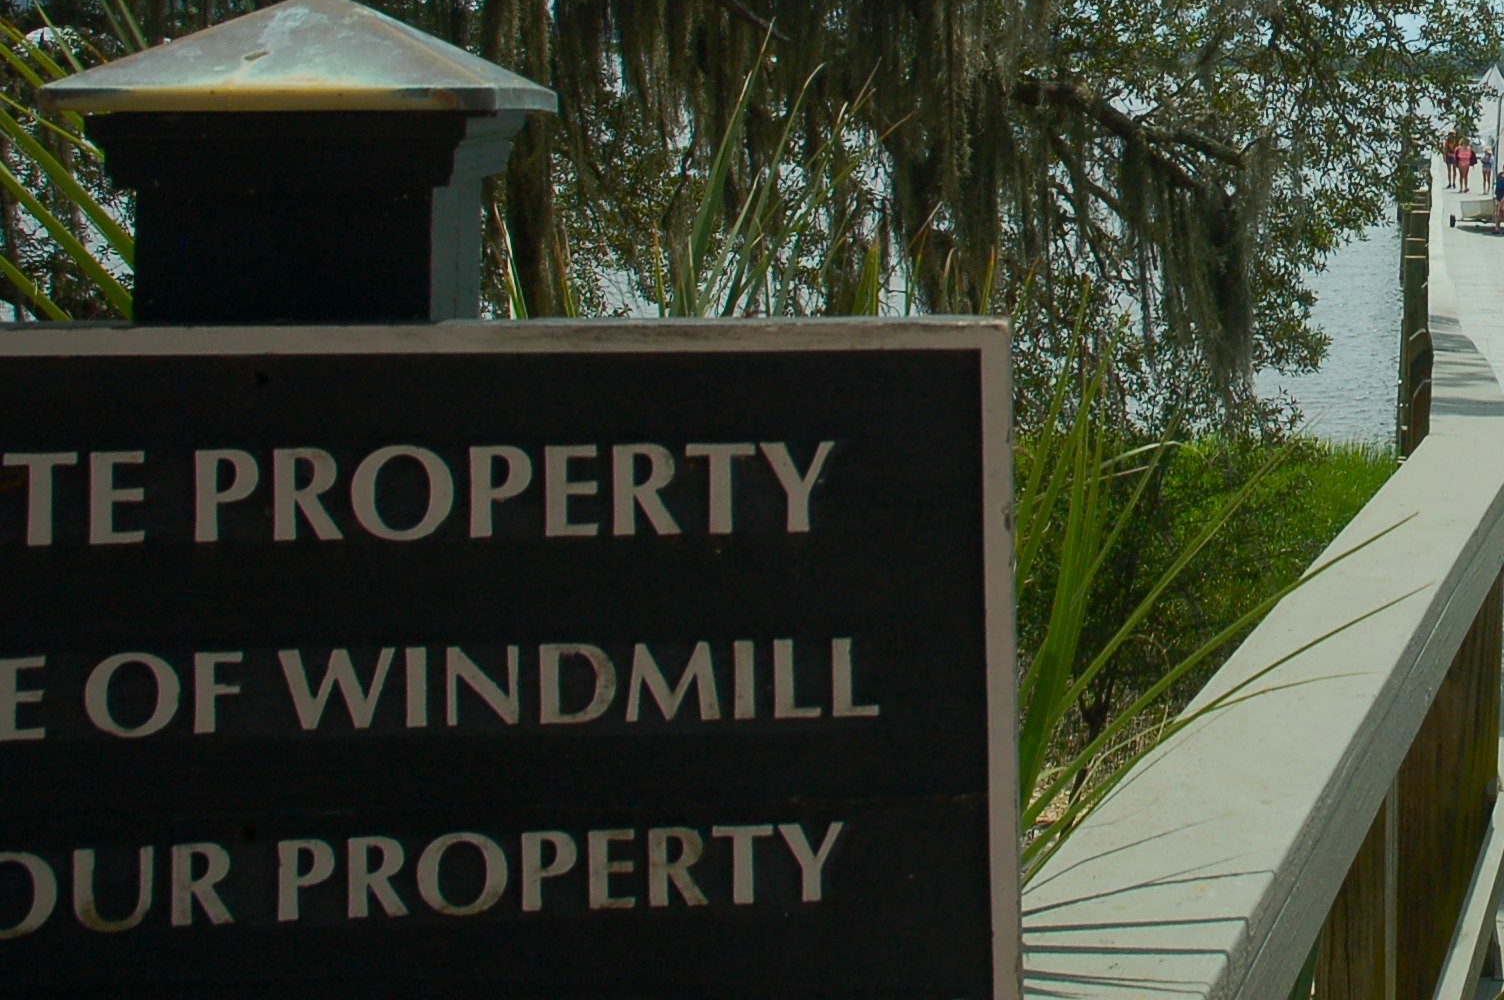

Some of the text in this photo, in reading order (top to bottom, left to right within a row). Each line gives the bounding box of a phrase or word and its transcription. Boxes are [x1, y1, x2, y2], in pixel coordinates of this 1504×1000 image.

[194, 440, 835, 543] PROPERTY
[84, 651, 243, 737] OF
[277, 637, 880, 729] WINDMILL
[277, 821, 843, 922] PROPERTY
